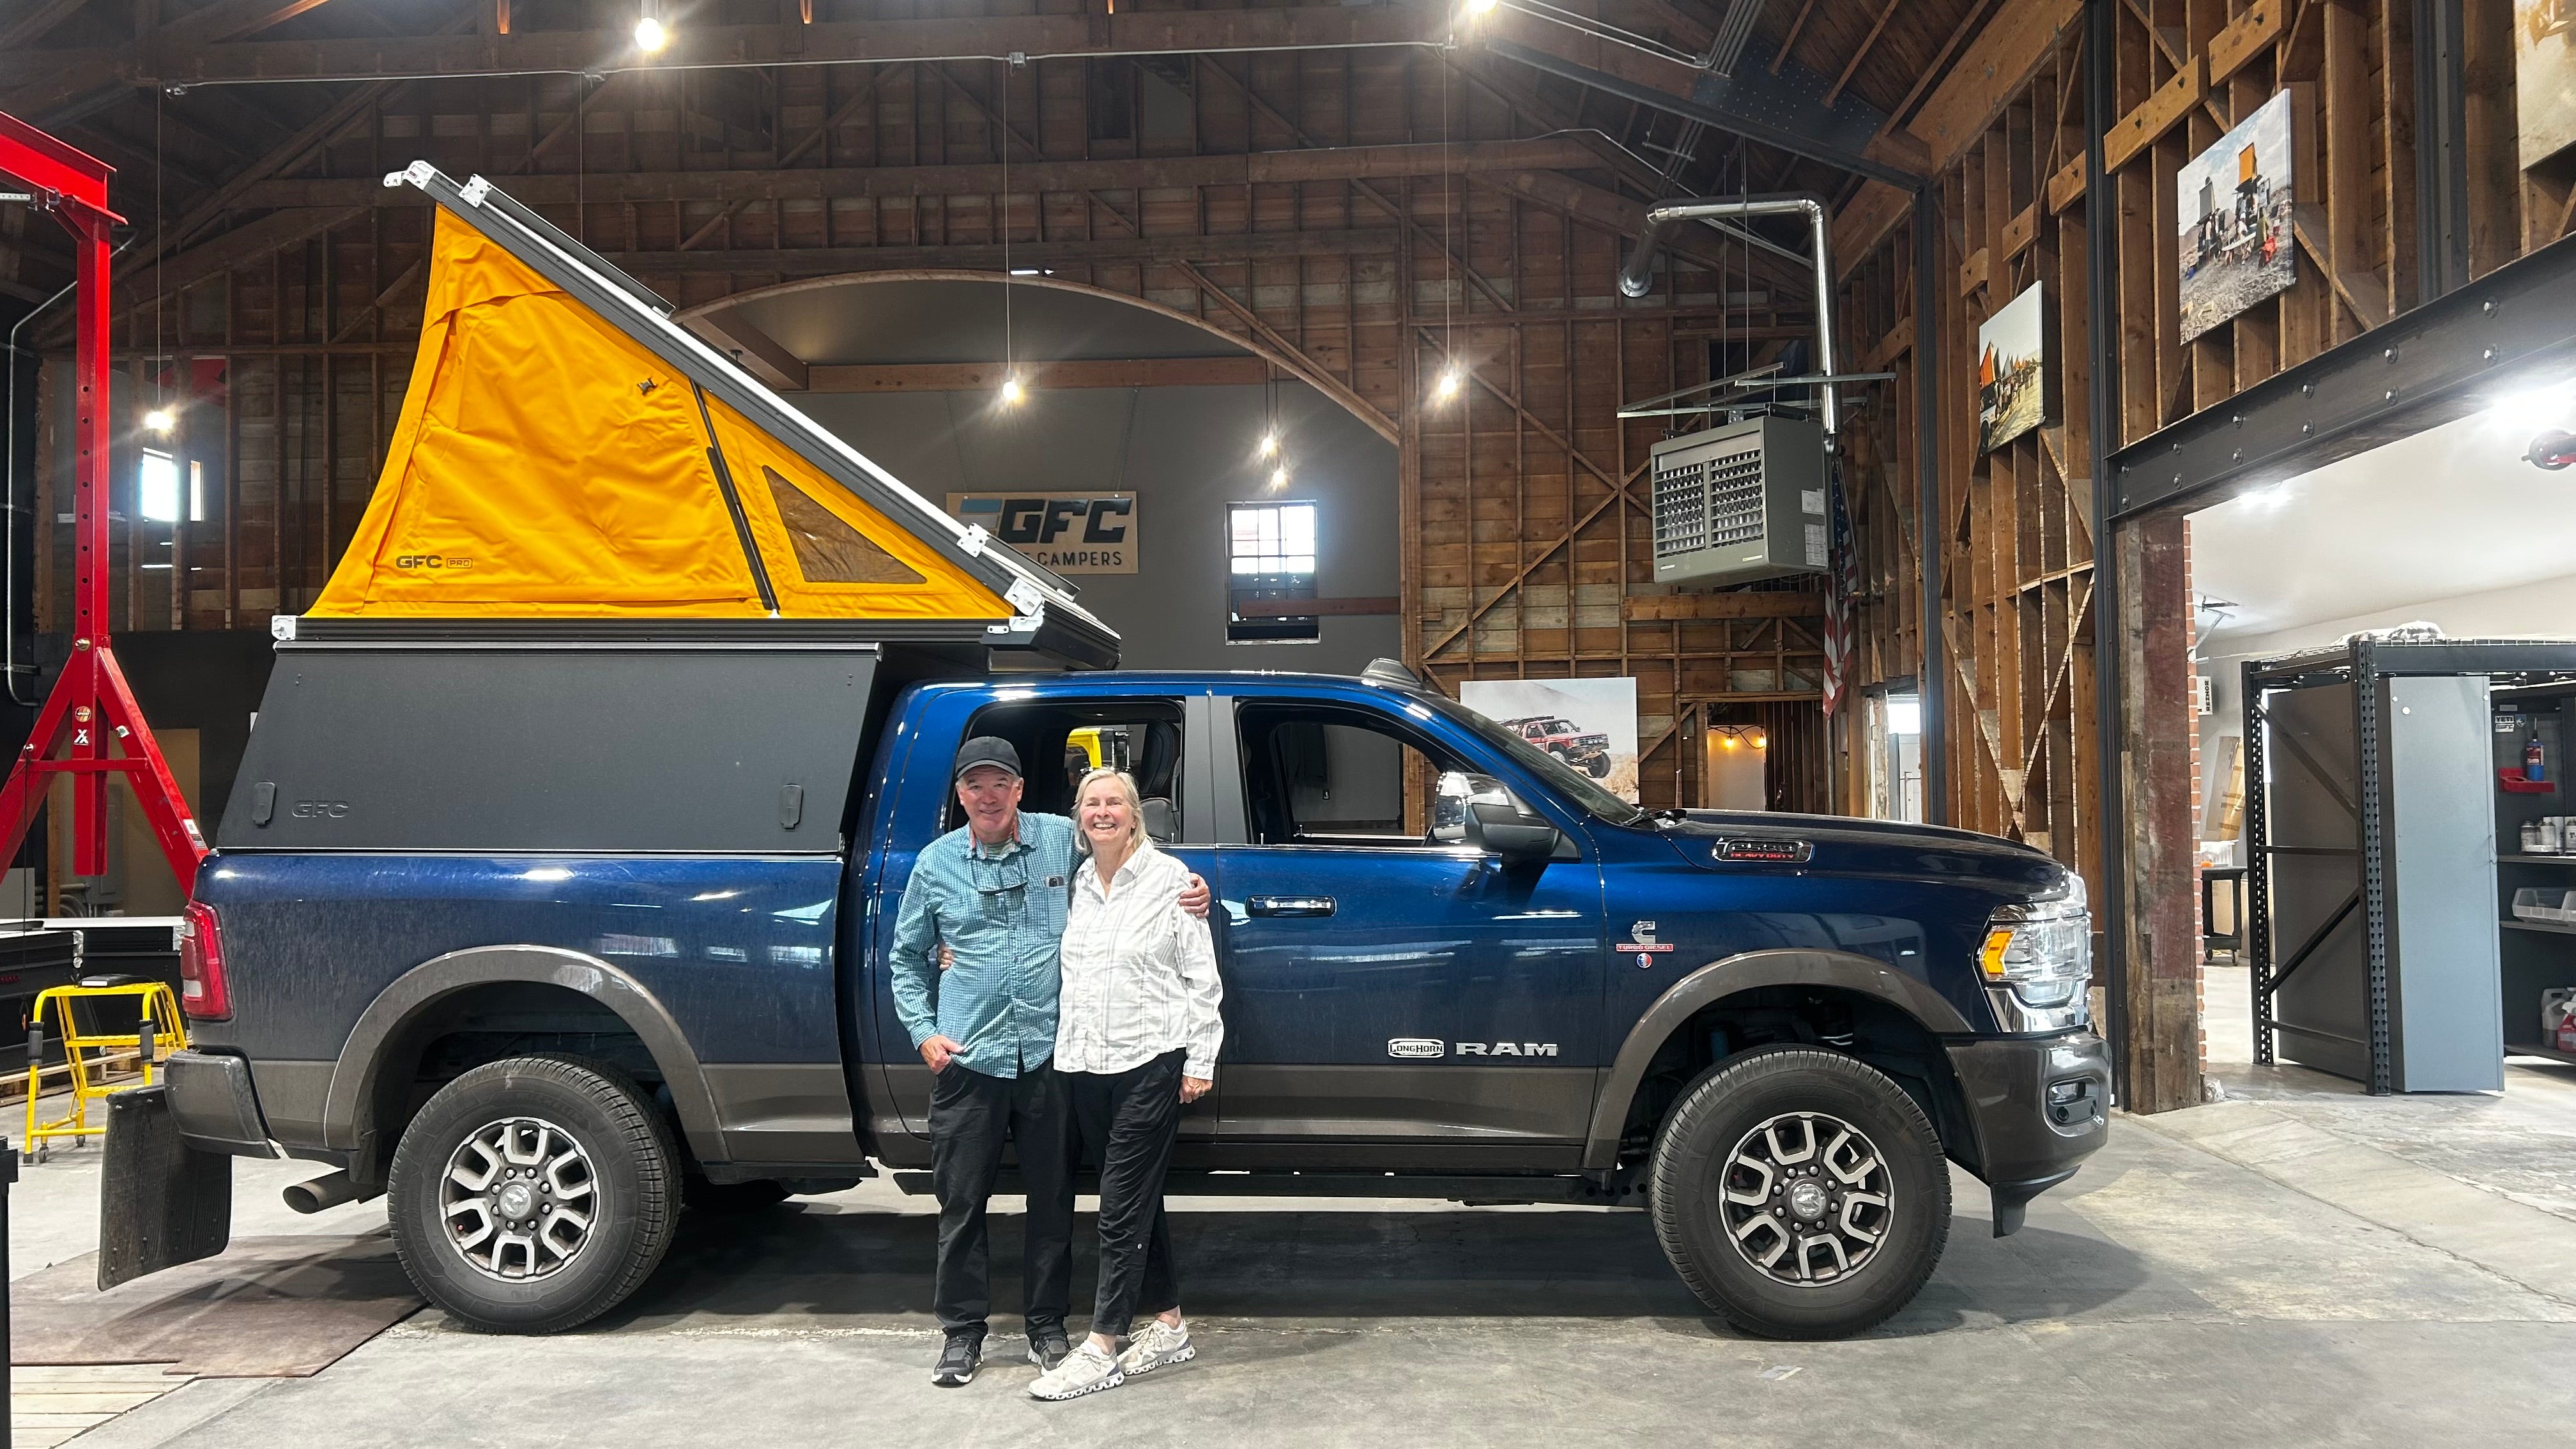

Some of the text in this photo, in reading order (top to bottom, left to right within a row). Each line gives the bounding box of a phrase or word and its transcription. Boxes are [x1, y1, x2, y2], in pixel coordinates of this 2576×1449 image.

[998, 498, 1132, 543] GFC
[395, 555, 443, 569] GFC
[1038, 551, 1122, 565] CAMPERS
[291, 800, 349, 818] GFC
[1455, 1042, 1558, 1056] RAM
